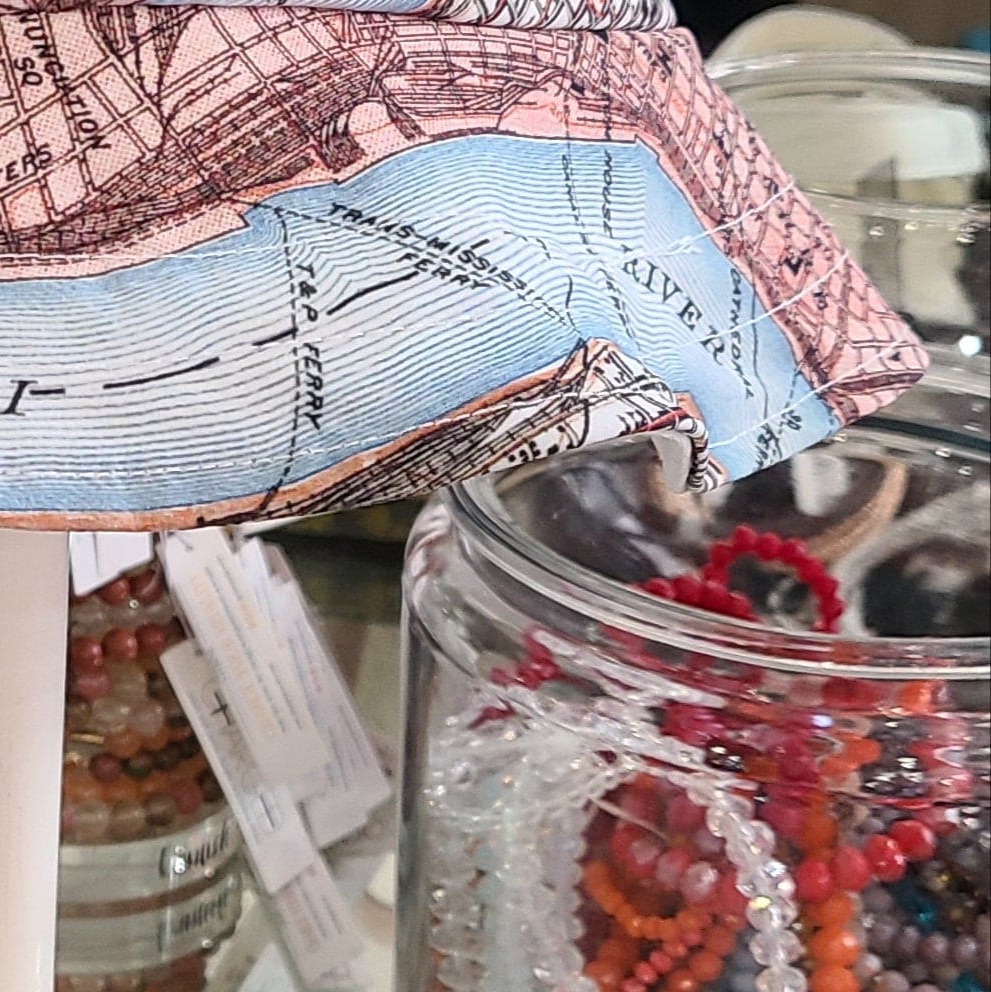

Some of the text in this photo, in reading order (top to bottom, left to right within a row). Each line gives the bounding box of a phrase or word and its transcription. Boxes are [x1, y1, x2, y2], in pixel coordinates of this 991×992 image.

[13, 57, 43, 87] SQ
[396, 251, 493, 290] FERRY
[619, 244, 725, 366] RIVER
[302, 341, 324, 431] FERRY
